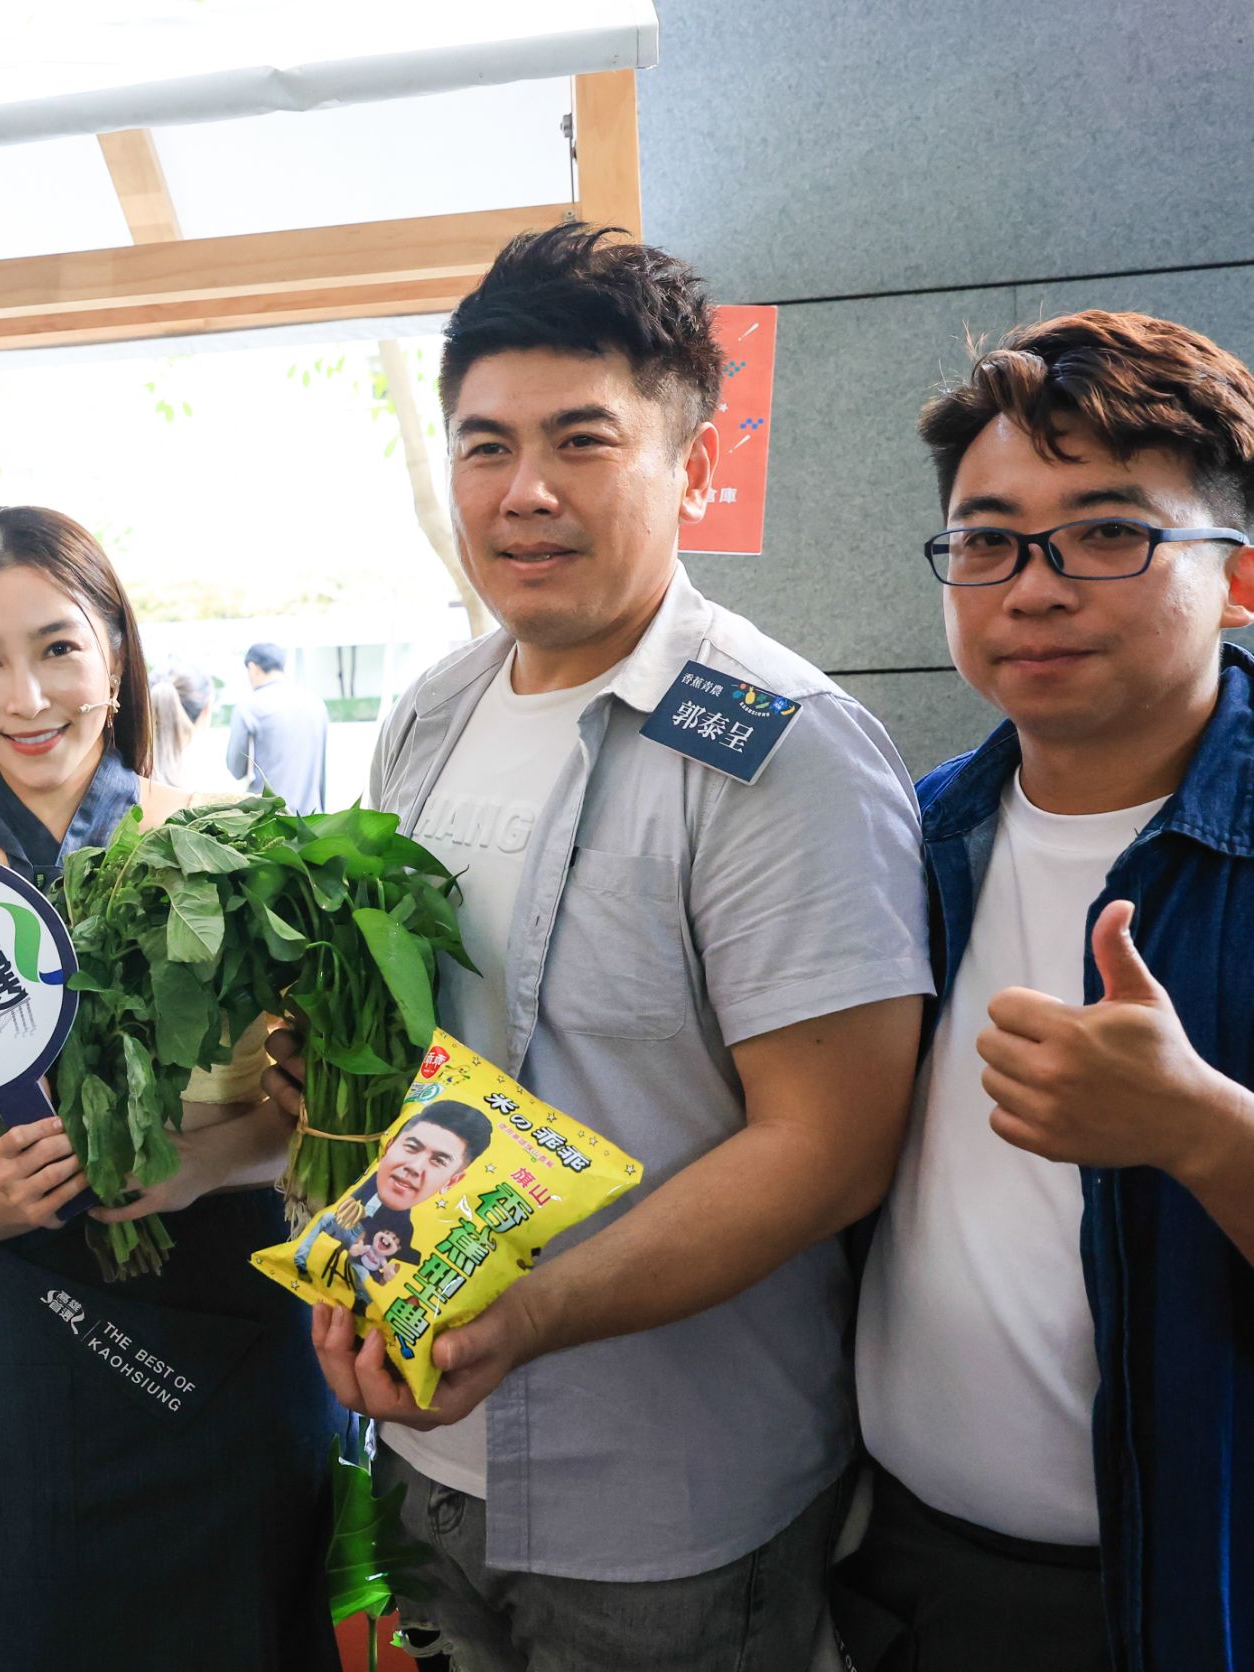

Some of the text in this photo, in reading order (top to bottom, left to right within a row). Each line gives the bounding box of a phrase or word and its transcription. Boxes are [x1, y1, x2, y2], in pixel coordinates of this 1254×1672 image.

[682, 673, 724, 698] 香蕉青農
[672, 700, 755, 753] 郭泰呈
[483, 1092, 592, 1174] 米の乖乖
[510, 1167, 552, 1207] 旗山
[384, 1181, 535, 1346] 香蕉型農
[87, 1337, 182, 1412] KAOHSIUNG
[103, 1321, 196, 1393] THE BEST OF
